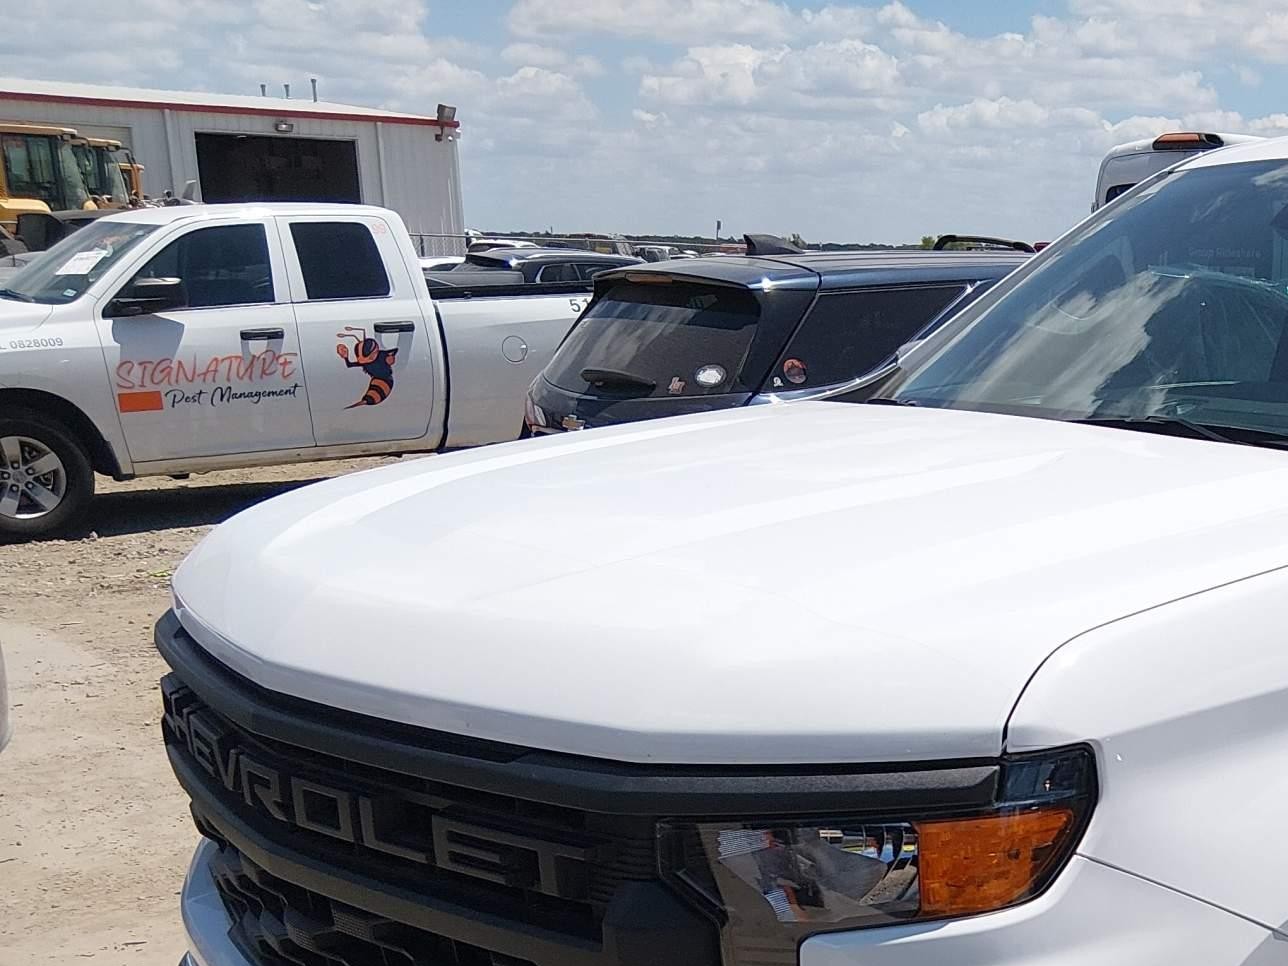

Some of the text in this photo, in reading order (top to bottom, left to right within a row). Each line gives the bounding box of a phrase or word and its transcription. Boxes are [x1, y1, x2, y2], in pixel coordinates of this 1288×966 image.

[9, 337, 64, 350] 0828009
[115, 350, 299, 390] SIGNATURE
[165, 382, 305, 409] Pest Management
